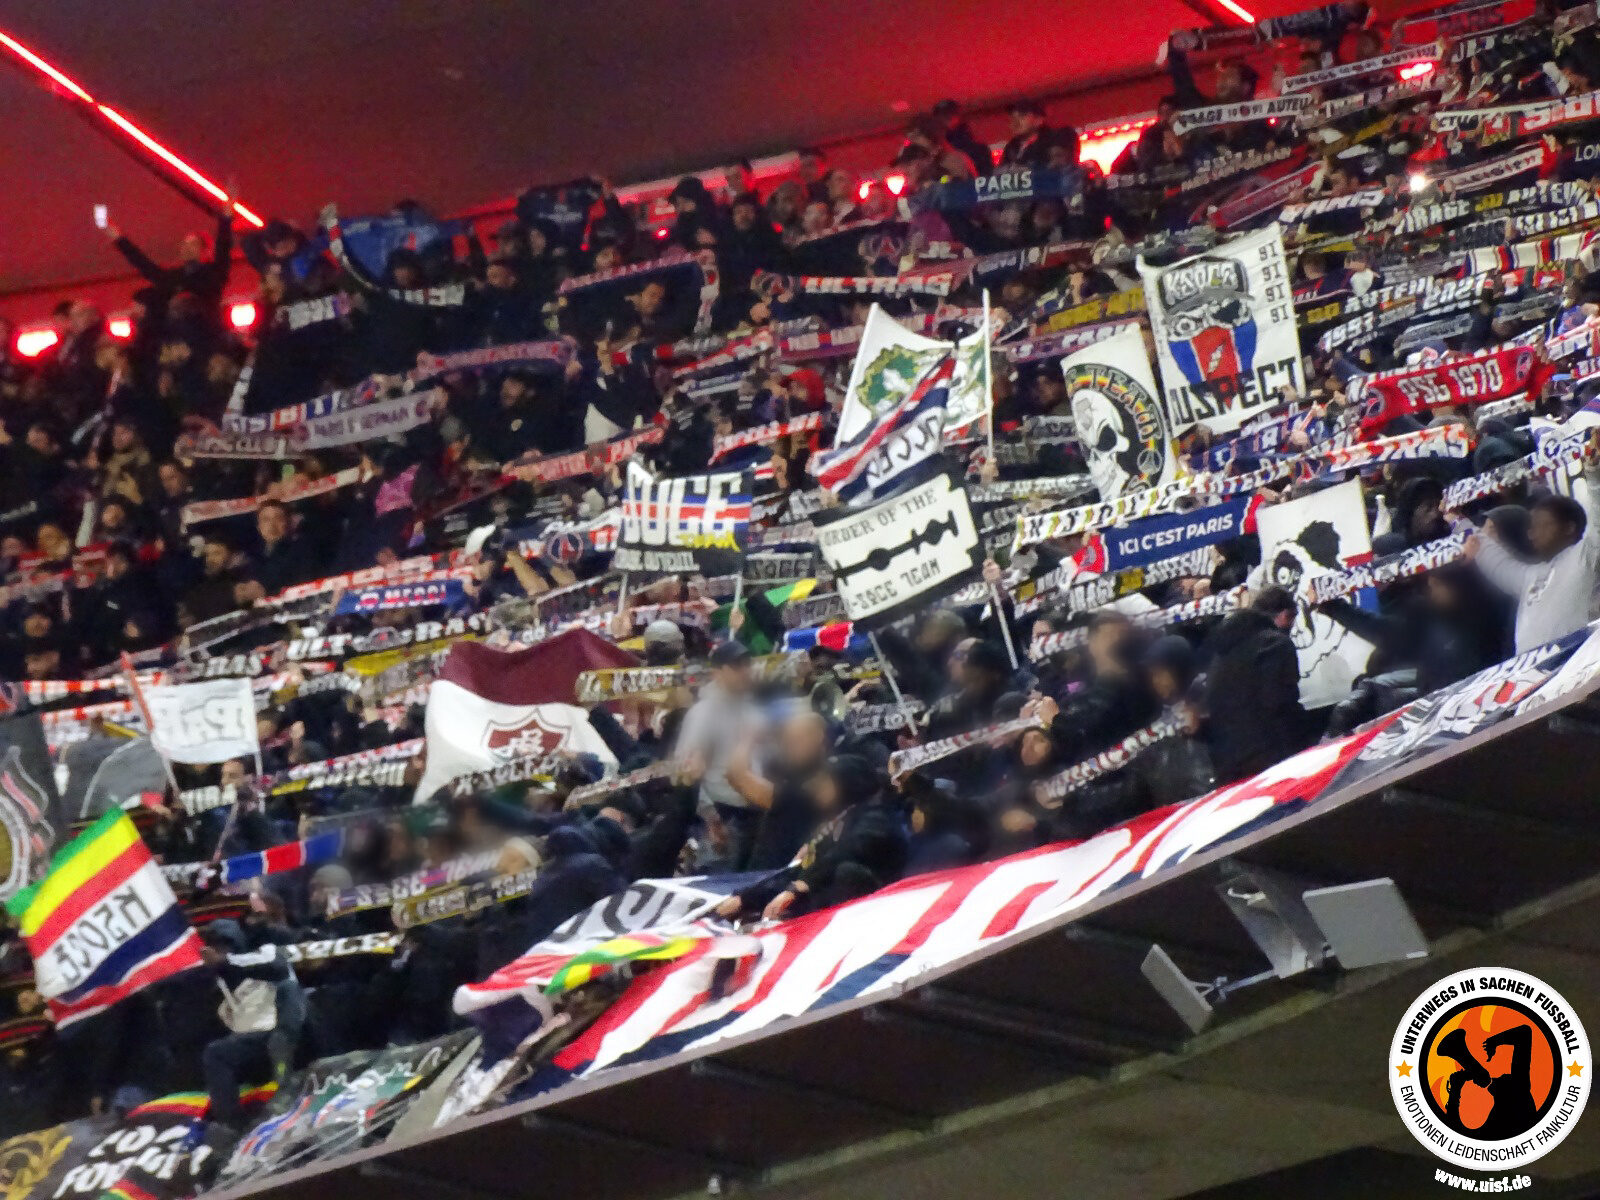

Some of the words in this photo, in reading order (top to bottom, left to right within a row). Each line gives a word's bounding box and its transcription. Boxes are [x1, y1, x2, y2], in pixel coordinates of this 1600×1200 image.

[975, 171, 1033, 194] PARIS
[1397, 373, 1450, 406] PSG
[1449, 358, 1503, 397] 1970
[877, 509, 898, 527] OF
[902, 488, 938, 514] THE
[1119, 538, 1138, 556] ICI
[1141, 527, 1184, 551] C'EST
[1186, 514, 1234, 540] PARIS
[901, 558, 941, 587] TEAM
